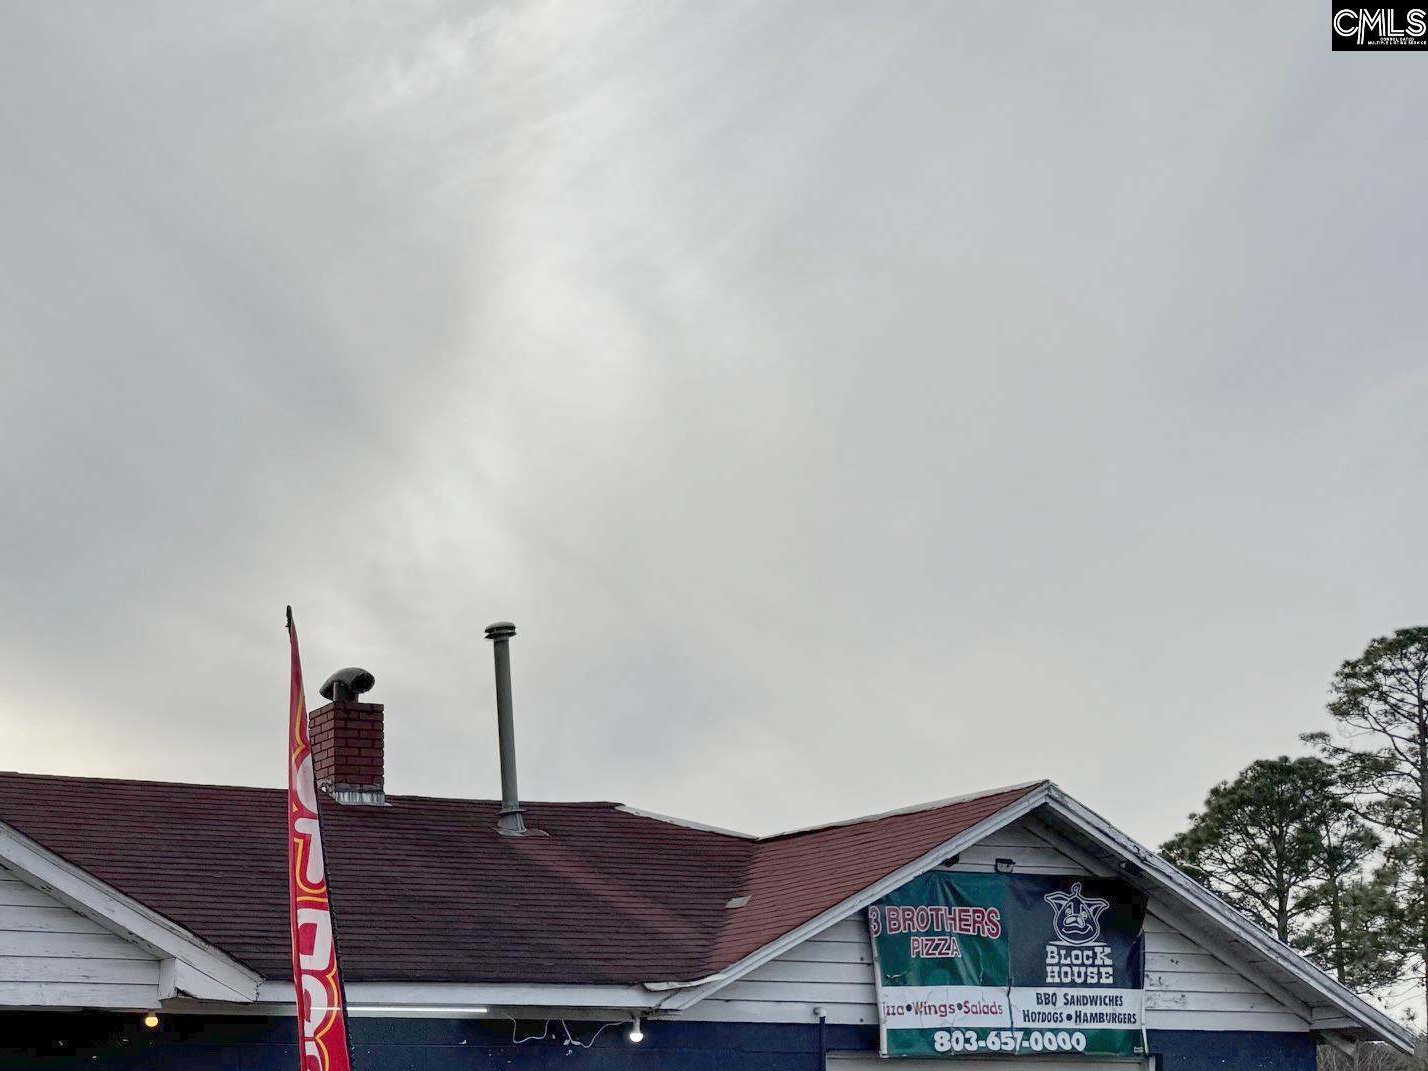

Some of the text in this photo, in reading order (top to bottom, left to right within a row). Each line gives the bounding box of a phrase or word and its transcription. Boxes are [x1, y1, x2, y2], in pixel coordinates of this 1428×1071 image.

[868, 905, 1002, 939] 3 BROTHERS
[910, 936, 962, 958] PIZZA
[1045, 945, 1113, 966] BLOCK
[1045, 965, 1113, 984] HOUSE
[912, 1001, 956, 1018] Wings
[962, 1000, 1004, 1016] Salads
[1035, 992, 1124, 1007] BBQ SANDWICHES
[1022, 1009, 1137, 1025] HOTDOGS HAMBURGERS
[933, 1030, 1087, 1053] 803-657-0000
